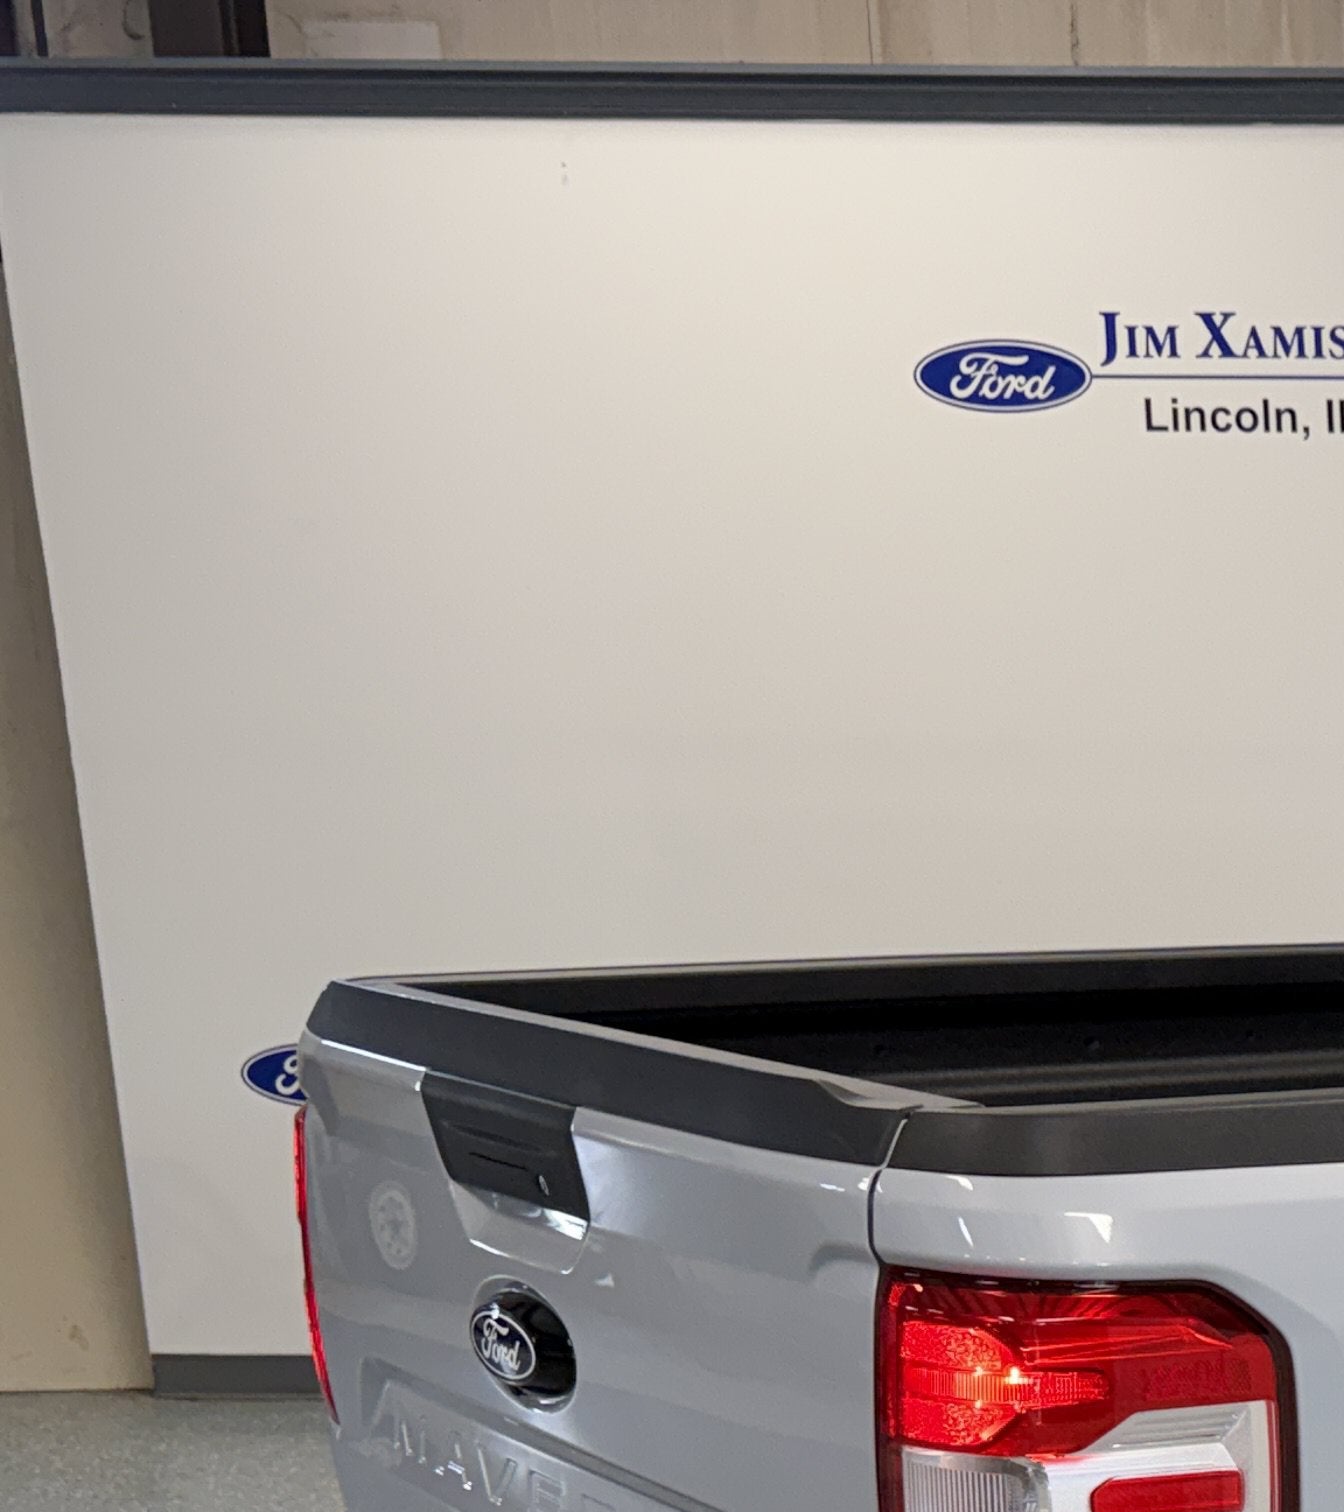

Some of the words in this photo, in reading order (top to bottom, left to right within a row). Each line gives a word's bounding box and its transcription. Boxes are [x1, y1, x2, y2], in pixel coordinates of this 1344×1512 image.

[948, 352, 1056, 402] Ford
[1144, 398, 1311, 441] Lincoln,
[480, 1317, 521, 1372] Ford
